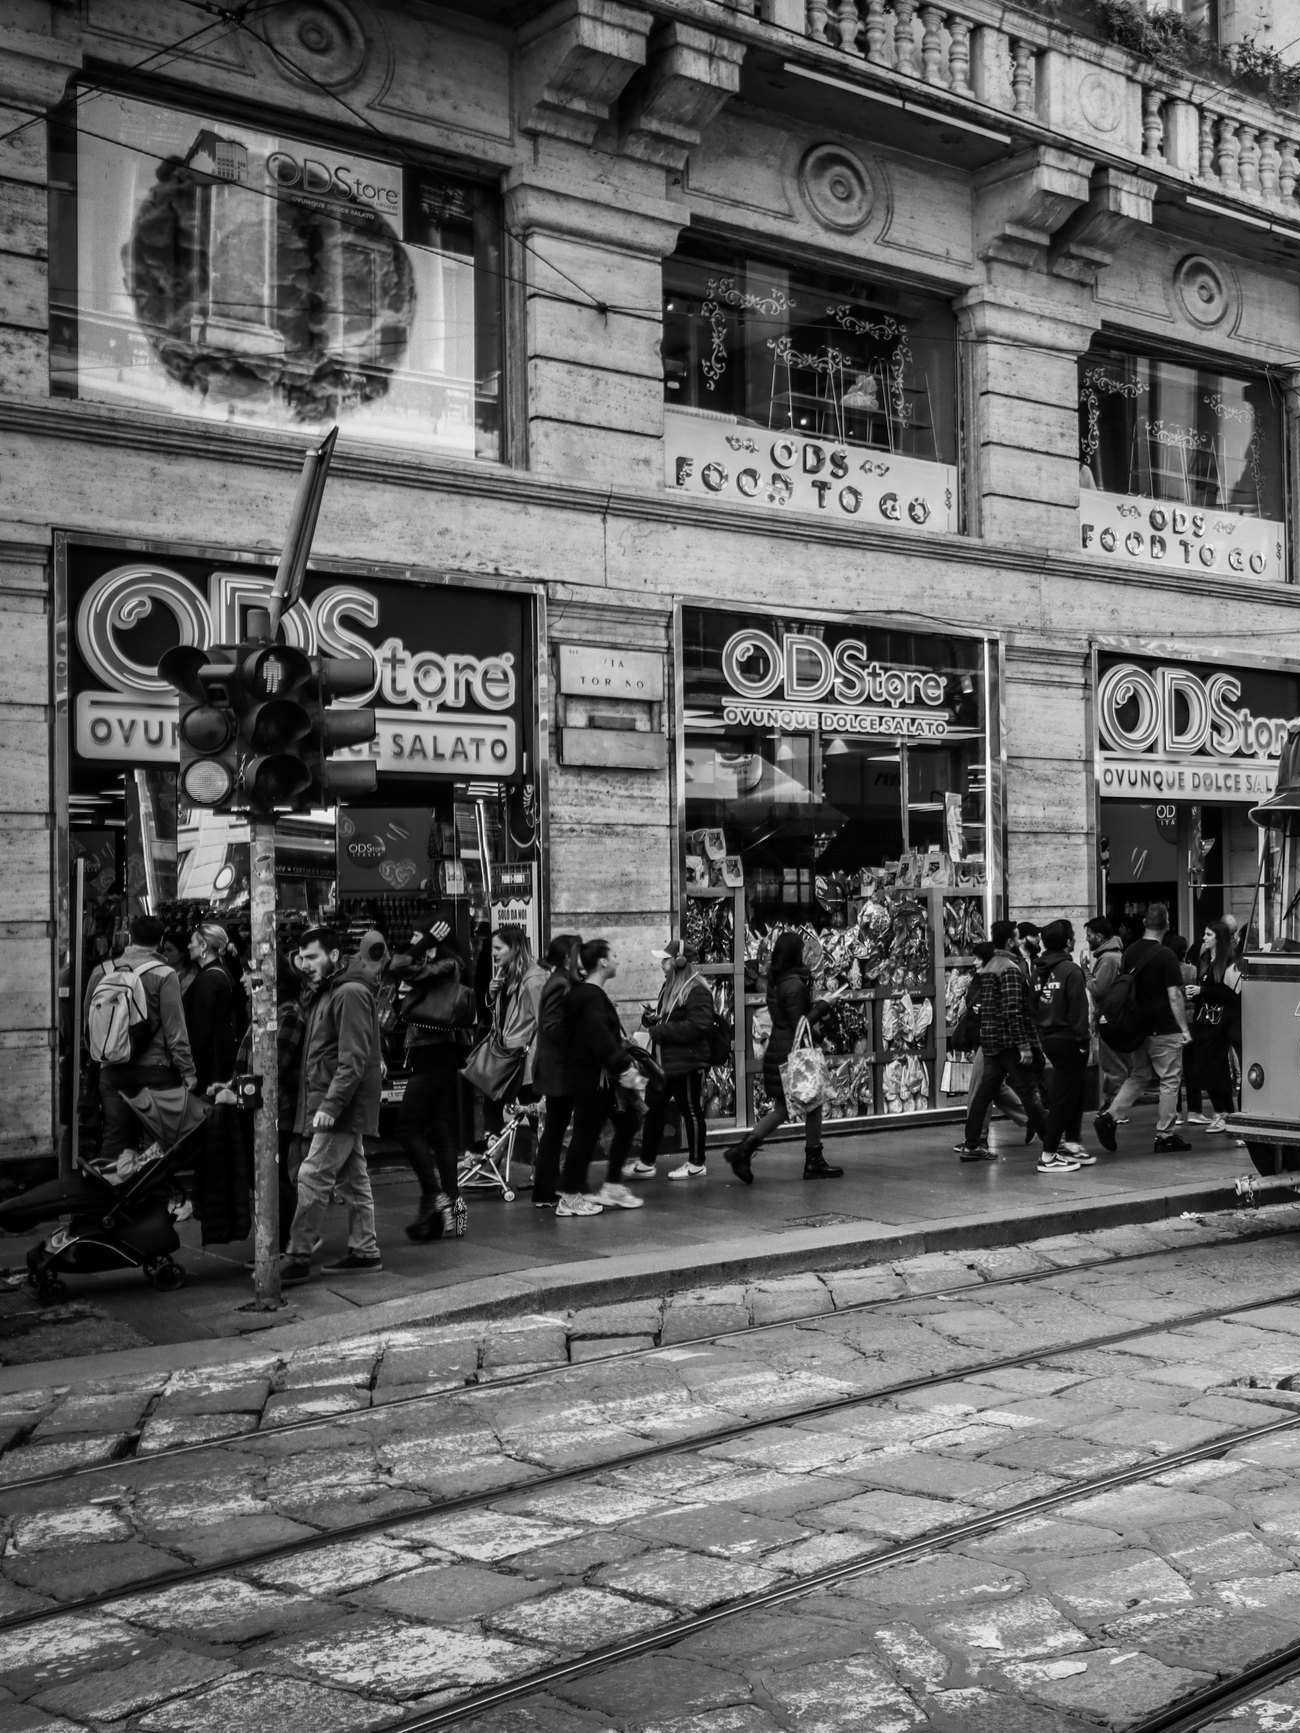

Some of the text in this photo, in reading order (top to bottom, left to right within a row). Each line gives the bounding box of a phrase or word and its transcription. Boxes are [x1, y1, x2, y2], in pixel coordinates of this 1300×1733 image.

[266, 152, 398, 204] ODStore
[770, 438, 849, 480] ODS
[811, 479, 863, 513] TO
[879, 491, 931, 524] GO
[1149, 505, 1206, 538] ODS
[1082, 523, 1267, 574] FOOD TO GO
[722, 629, 946, 707] ODStore
[723, 707, 947, 736] OVUNQUE DOLCE SALATO
[392, 734, 508, 764] SALATO
[1103, 768, 1276, 793] OVUNQUE DOLCE SAL
